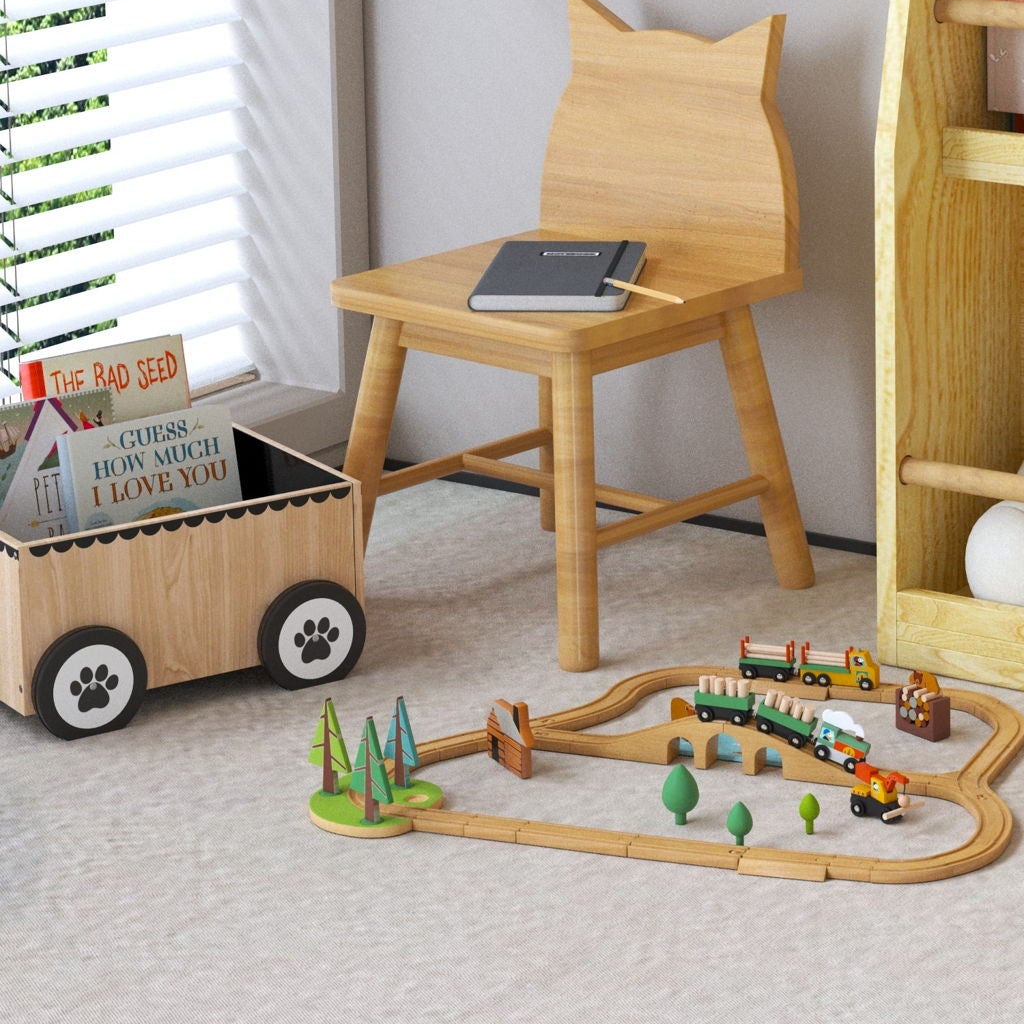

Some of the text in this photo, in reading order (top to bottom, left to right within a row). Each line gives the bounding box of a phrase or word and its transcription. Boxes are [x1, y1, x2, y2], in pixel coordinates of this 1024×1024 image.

[137, 350, 178, 390] SEED
[119, 419, 188, 450] GUESS
[93, 436, 221, 480] HOW MUCH
[91, 459, 228, 508] I LOVE YOU
